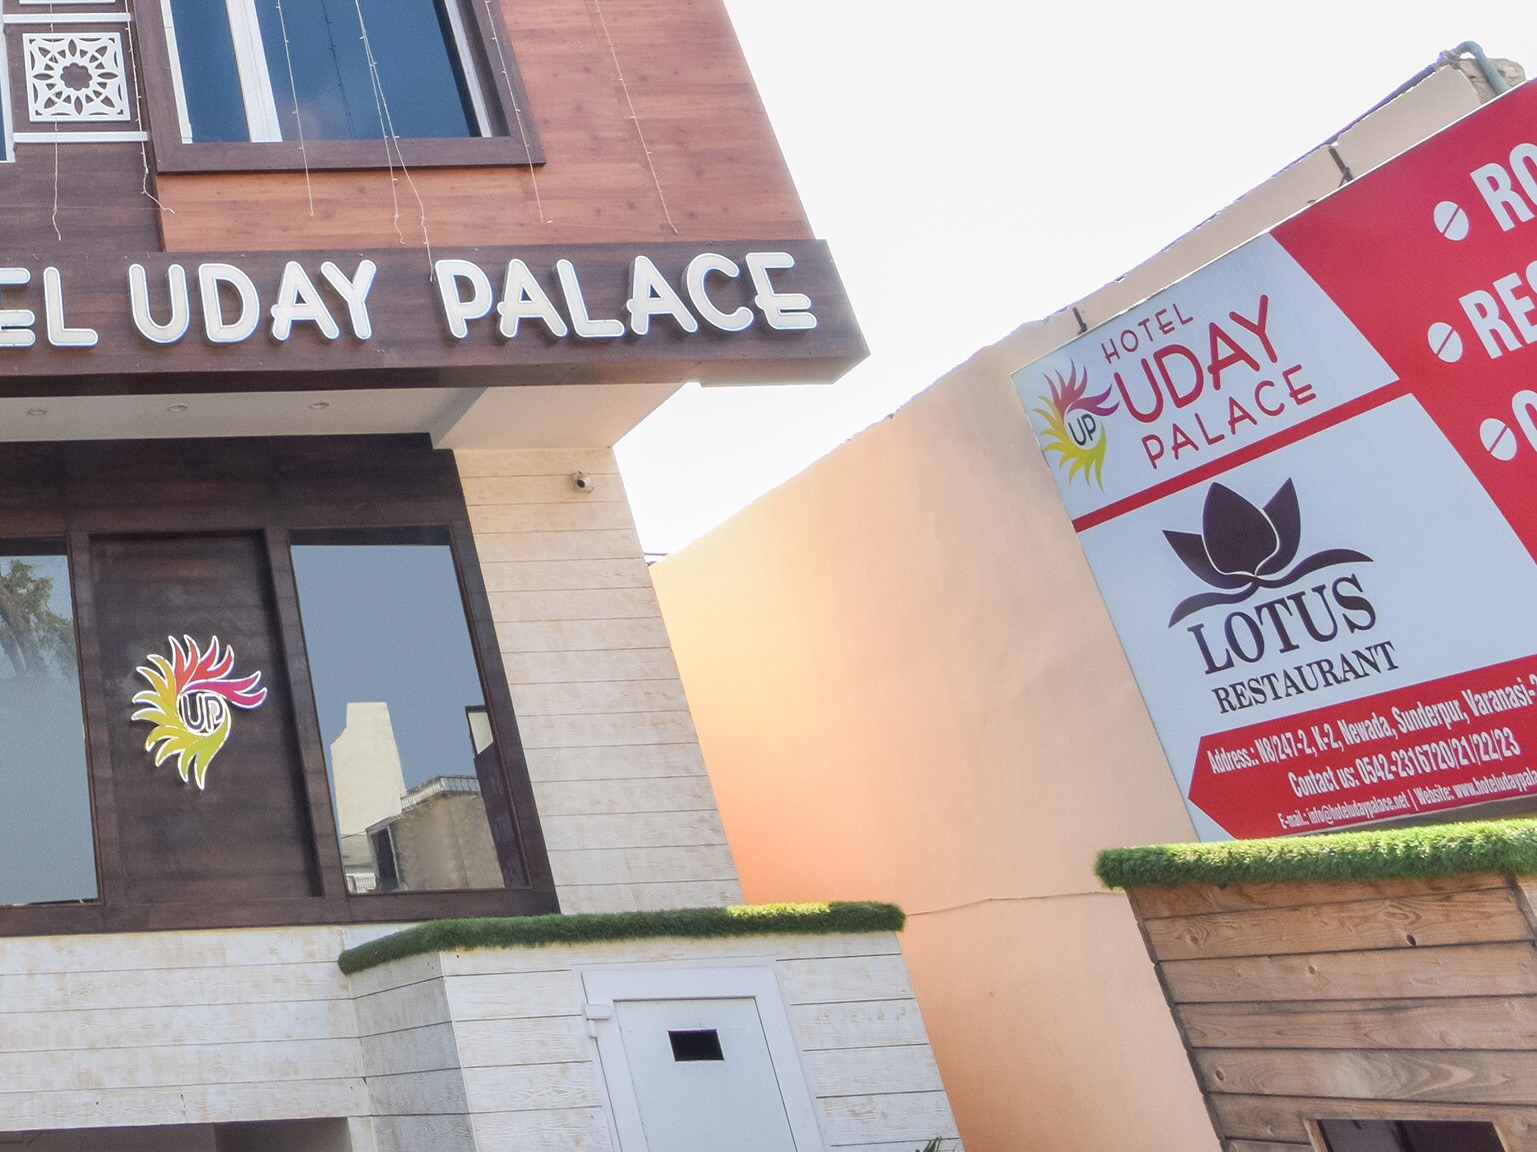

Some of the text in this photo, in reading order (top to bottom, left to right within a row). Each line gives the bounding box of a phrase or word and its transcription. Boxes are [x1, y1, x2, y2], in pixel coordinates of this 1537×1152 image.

[128, 259, 377, 344] UDAY
[433, 250, 819, 339] PALACE
[1100, 303, 1195, 365] HOTEL
[1114, 294, 1278, 424] UDAY
[1067, 412, 1097, 447] UP
[1141, 364, 1317, 470] PALACE
[1187, 573, 1377, 675] LOTUS
[181, 692, 225, 733] UP
[1211, 640, 1399, 714] RESTAURANT
[1288, 726, 1522, 798] Contact us: 0542-2316720/21/22/23
[1311, 723, 1345, 752] K-2,
[1337, 712, 1399, 746] Newada,
[1391, 701, 1471, 740] Sunderpur,
[1413, 781, 1456, 805] Website:
